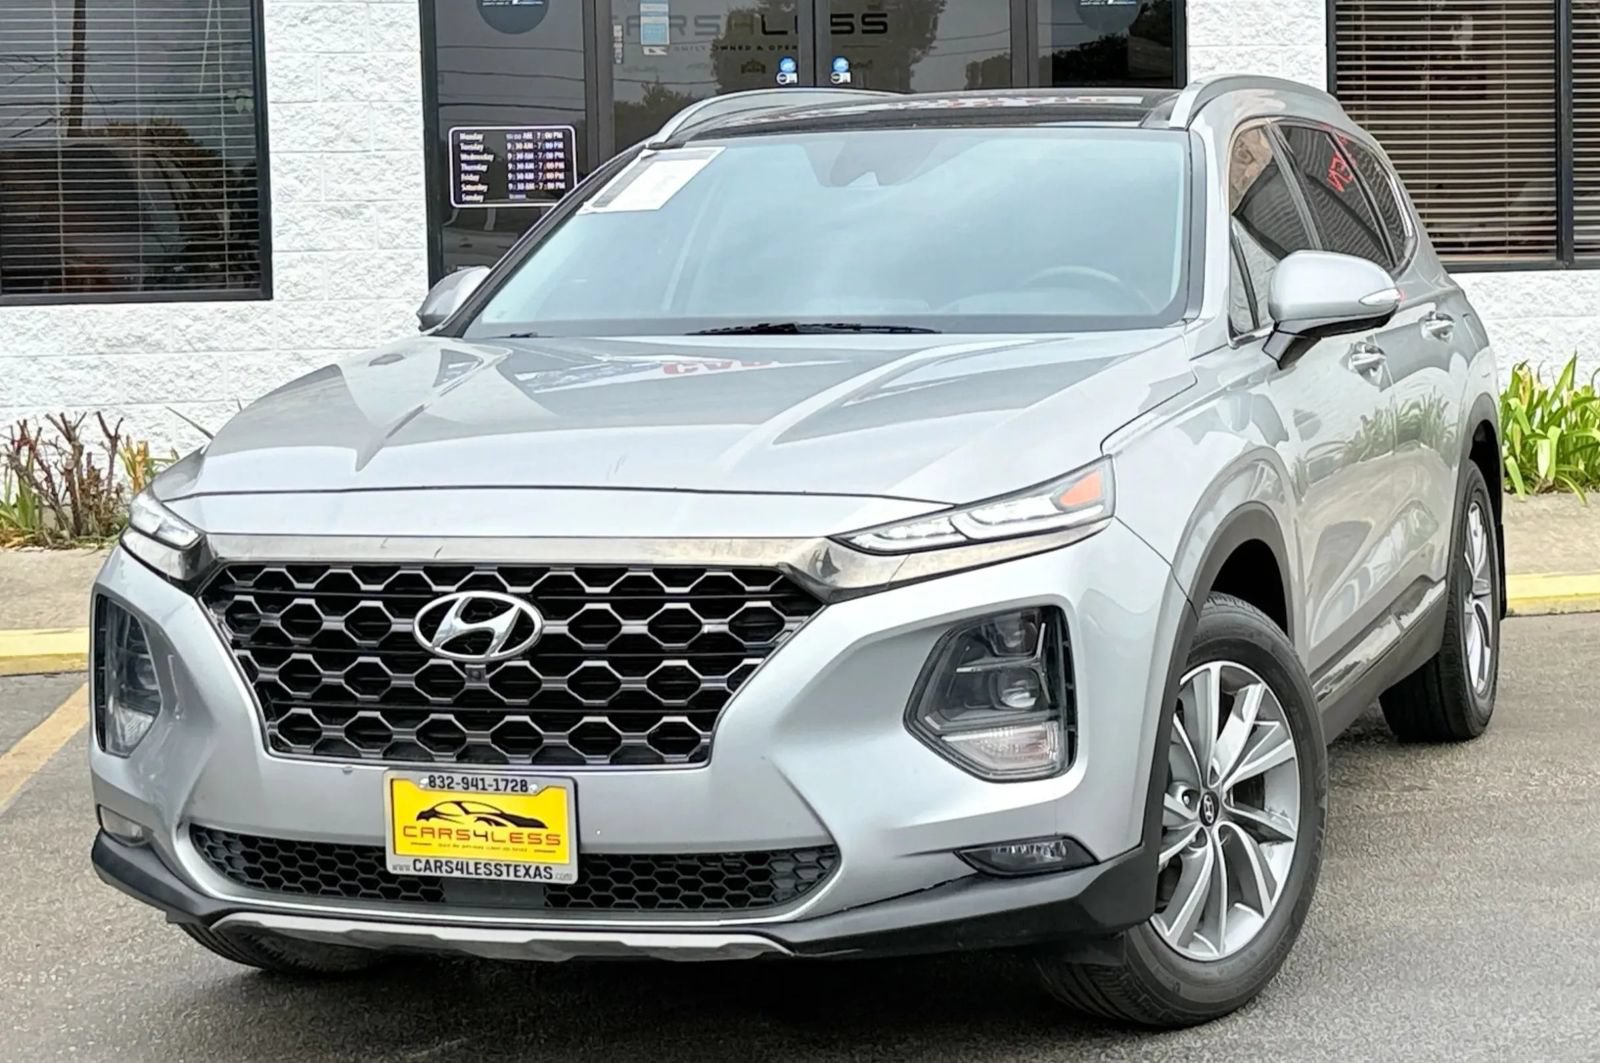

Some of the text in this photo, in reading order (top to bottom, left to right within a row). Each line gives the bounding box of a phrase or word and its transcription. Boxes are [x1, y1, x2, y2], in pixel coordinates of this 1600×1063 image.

[613, 13, 888, 37] ARS4LSS
[460, 133, 484, 142] Monday
[460, 153, 495, 162] Wednesday
[460, 164, 488, 172] Thursday
[461, 184, 488, 192] Saturday
[462, 194, 484, 202] Sunday
[428, 775, 529, 793] 832-941-1728
[403, 825, 561, 846] CARS4LESS
